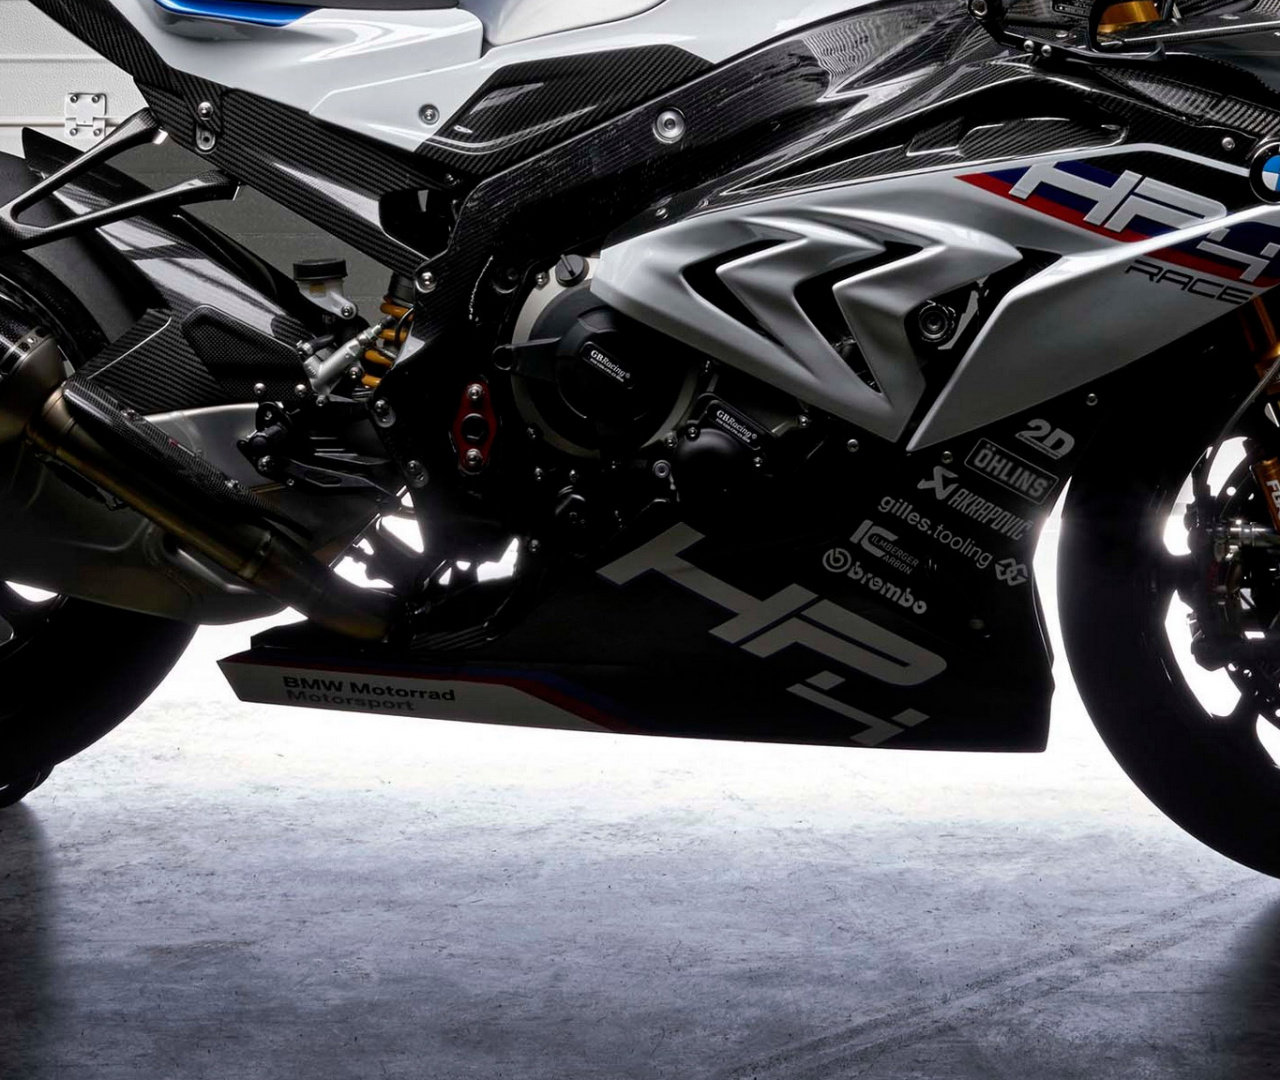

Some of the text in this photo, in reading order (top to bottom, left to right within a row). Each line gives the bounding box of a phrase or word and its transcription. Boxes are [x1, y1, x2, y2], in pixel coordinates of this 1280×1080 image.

[1125, 259, 1254, 305] RACE
[1014, 418, 1075, 460] 2D
[973, 443, 1049, 499] ÖHLINS
[876, 495, 994, 570] gilles.tooling
[845, 560, 929, 616] brembo
[282, 676, 456, 702] BMW Motorrad
[285, 689, 415, 711] Motorsport
